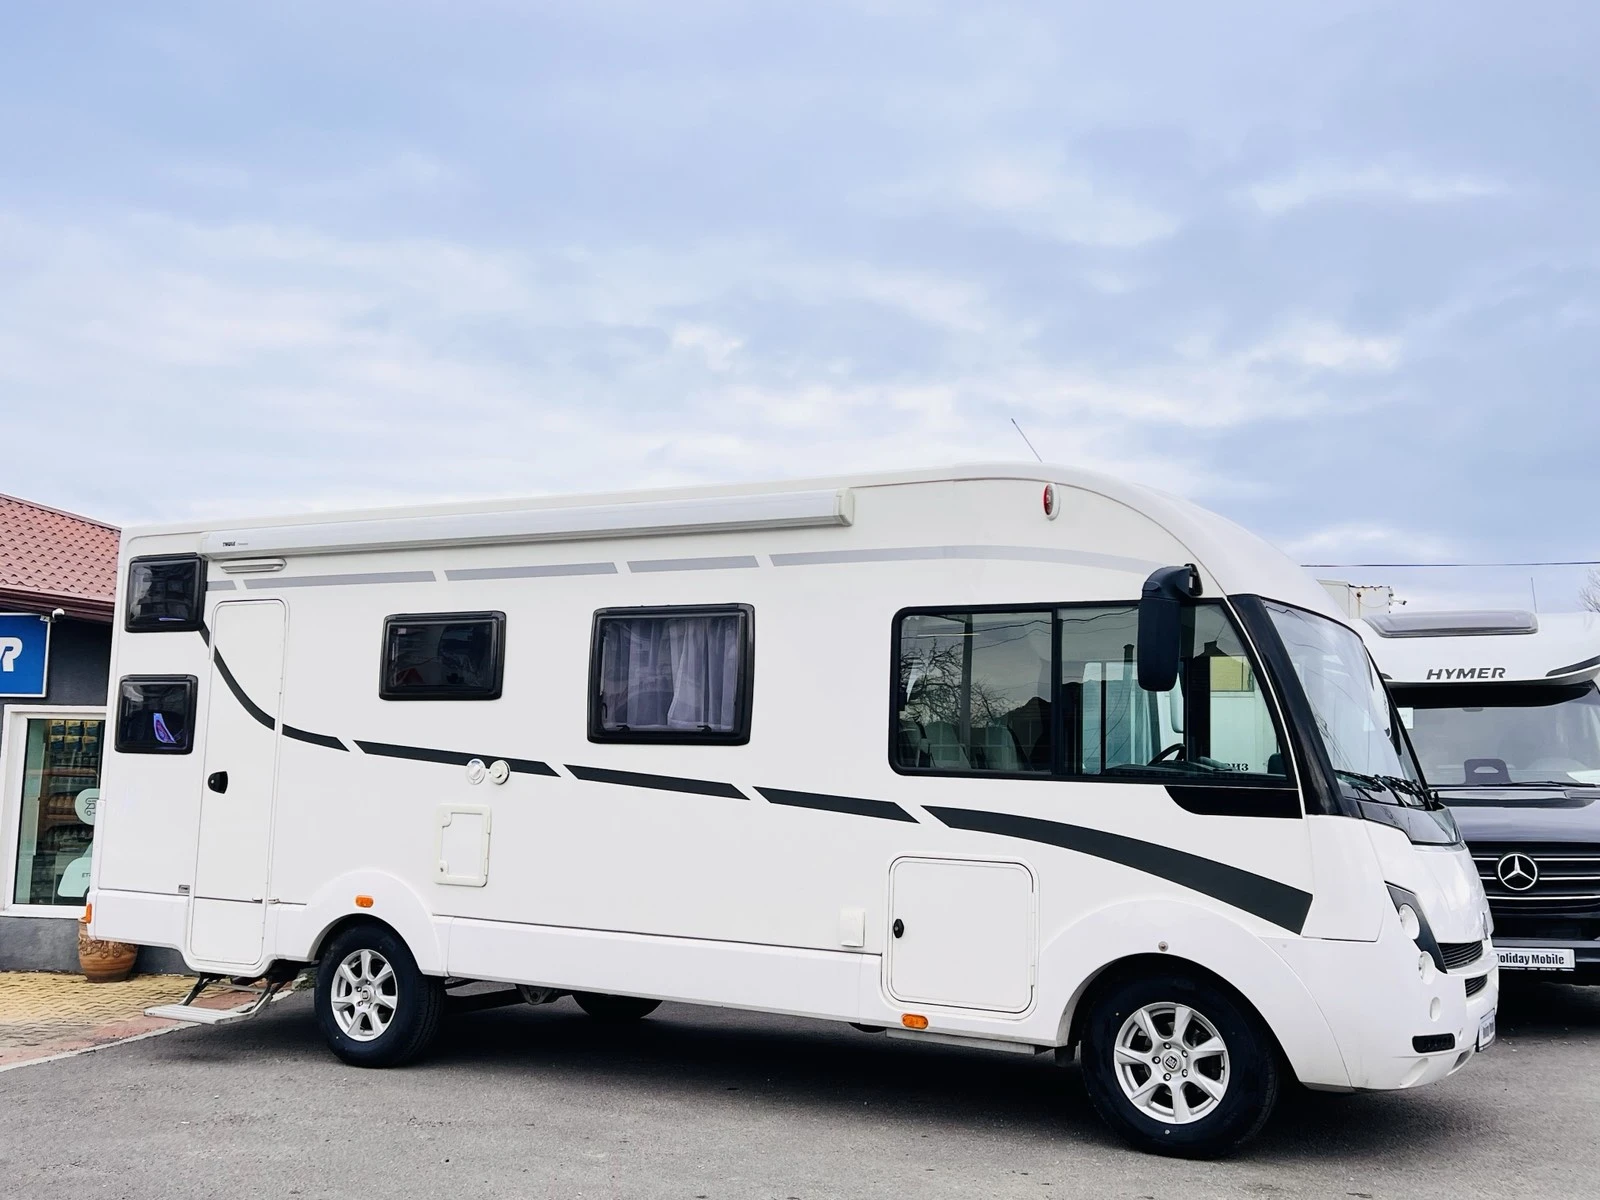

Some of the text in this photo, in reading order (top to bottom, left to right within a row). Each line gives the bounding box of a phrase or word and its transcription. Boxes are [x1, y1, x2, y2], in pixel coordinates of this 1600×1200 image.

[1426, 667, 1506, 680] HYMER
[1497, 952, 1565, 965] oliday Mobile
